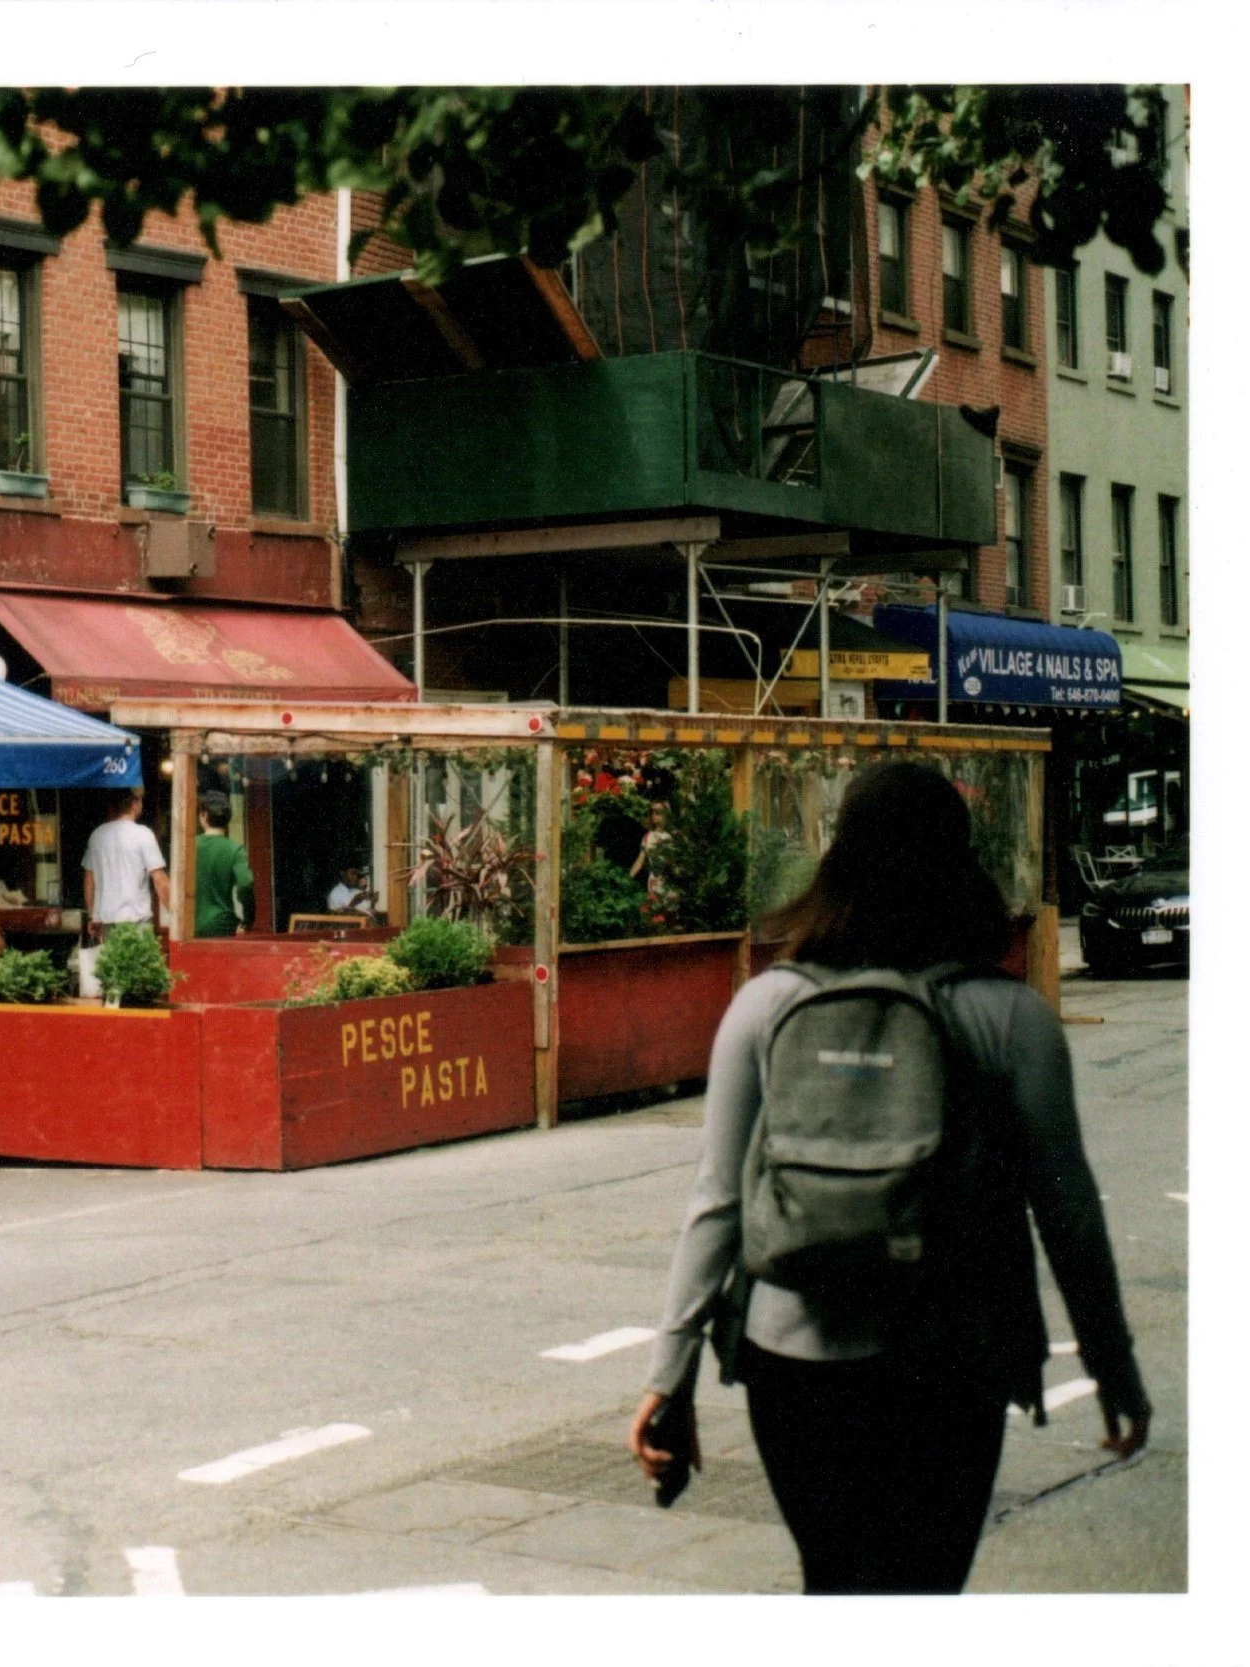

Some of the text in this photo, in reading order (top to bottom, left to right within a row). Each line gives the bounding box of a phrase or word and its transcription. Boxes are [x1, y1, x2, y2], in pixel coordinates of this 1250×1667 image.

[979, 648, 1034, 677] VILLAGE
[1036, 653, 1045, 678] 4
[1046, 654, 1081, 681] NAILS
[1084, 657, 1093, 682] &
[1096, 658, 1120, 682] SPA
[103, 756, 127, 774] 260
[341, 1010, 433, 1067] PESCE
[401, 1055, 488, 1109] PASTA
